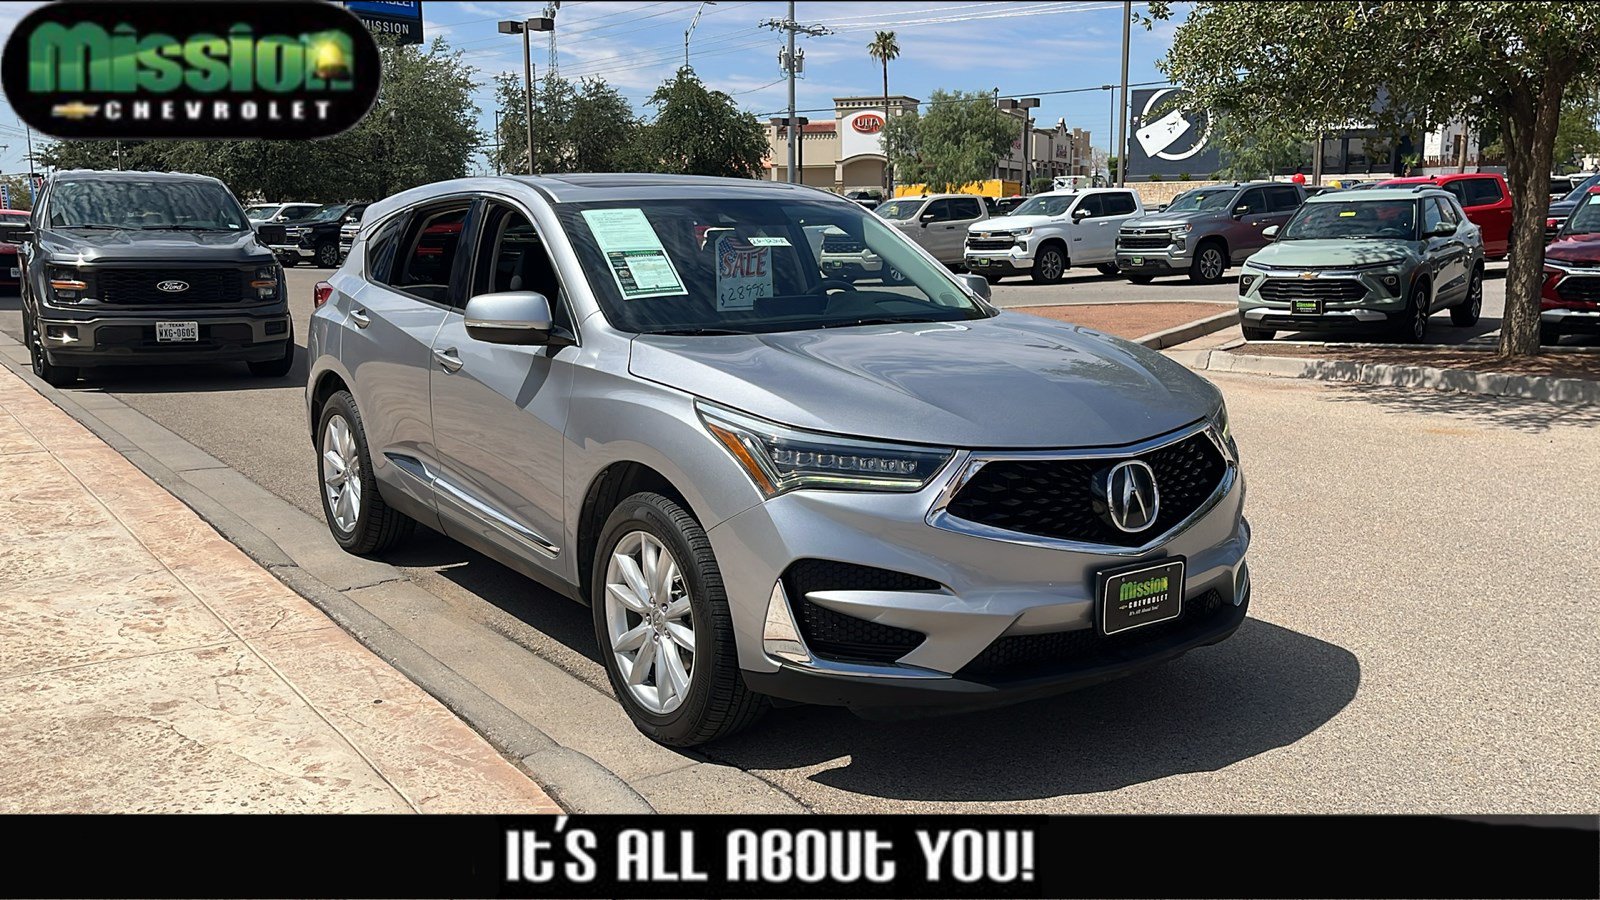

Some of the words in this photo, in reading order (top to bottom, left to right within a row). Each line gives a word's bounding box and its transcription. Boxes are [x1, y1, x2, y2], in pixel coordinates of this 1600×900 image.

[361, 18, 409, 35] MISSION
[857, 117, 881, 127] ULTA
[721, 252, 770, 279] SALE
[162, 282, 184, 290] Ford
[1119, 576, 1169, 602] Mission
[1128, 593, 1168, 609] CHEVROLET
